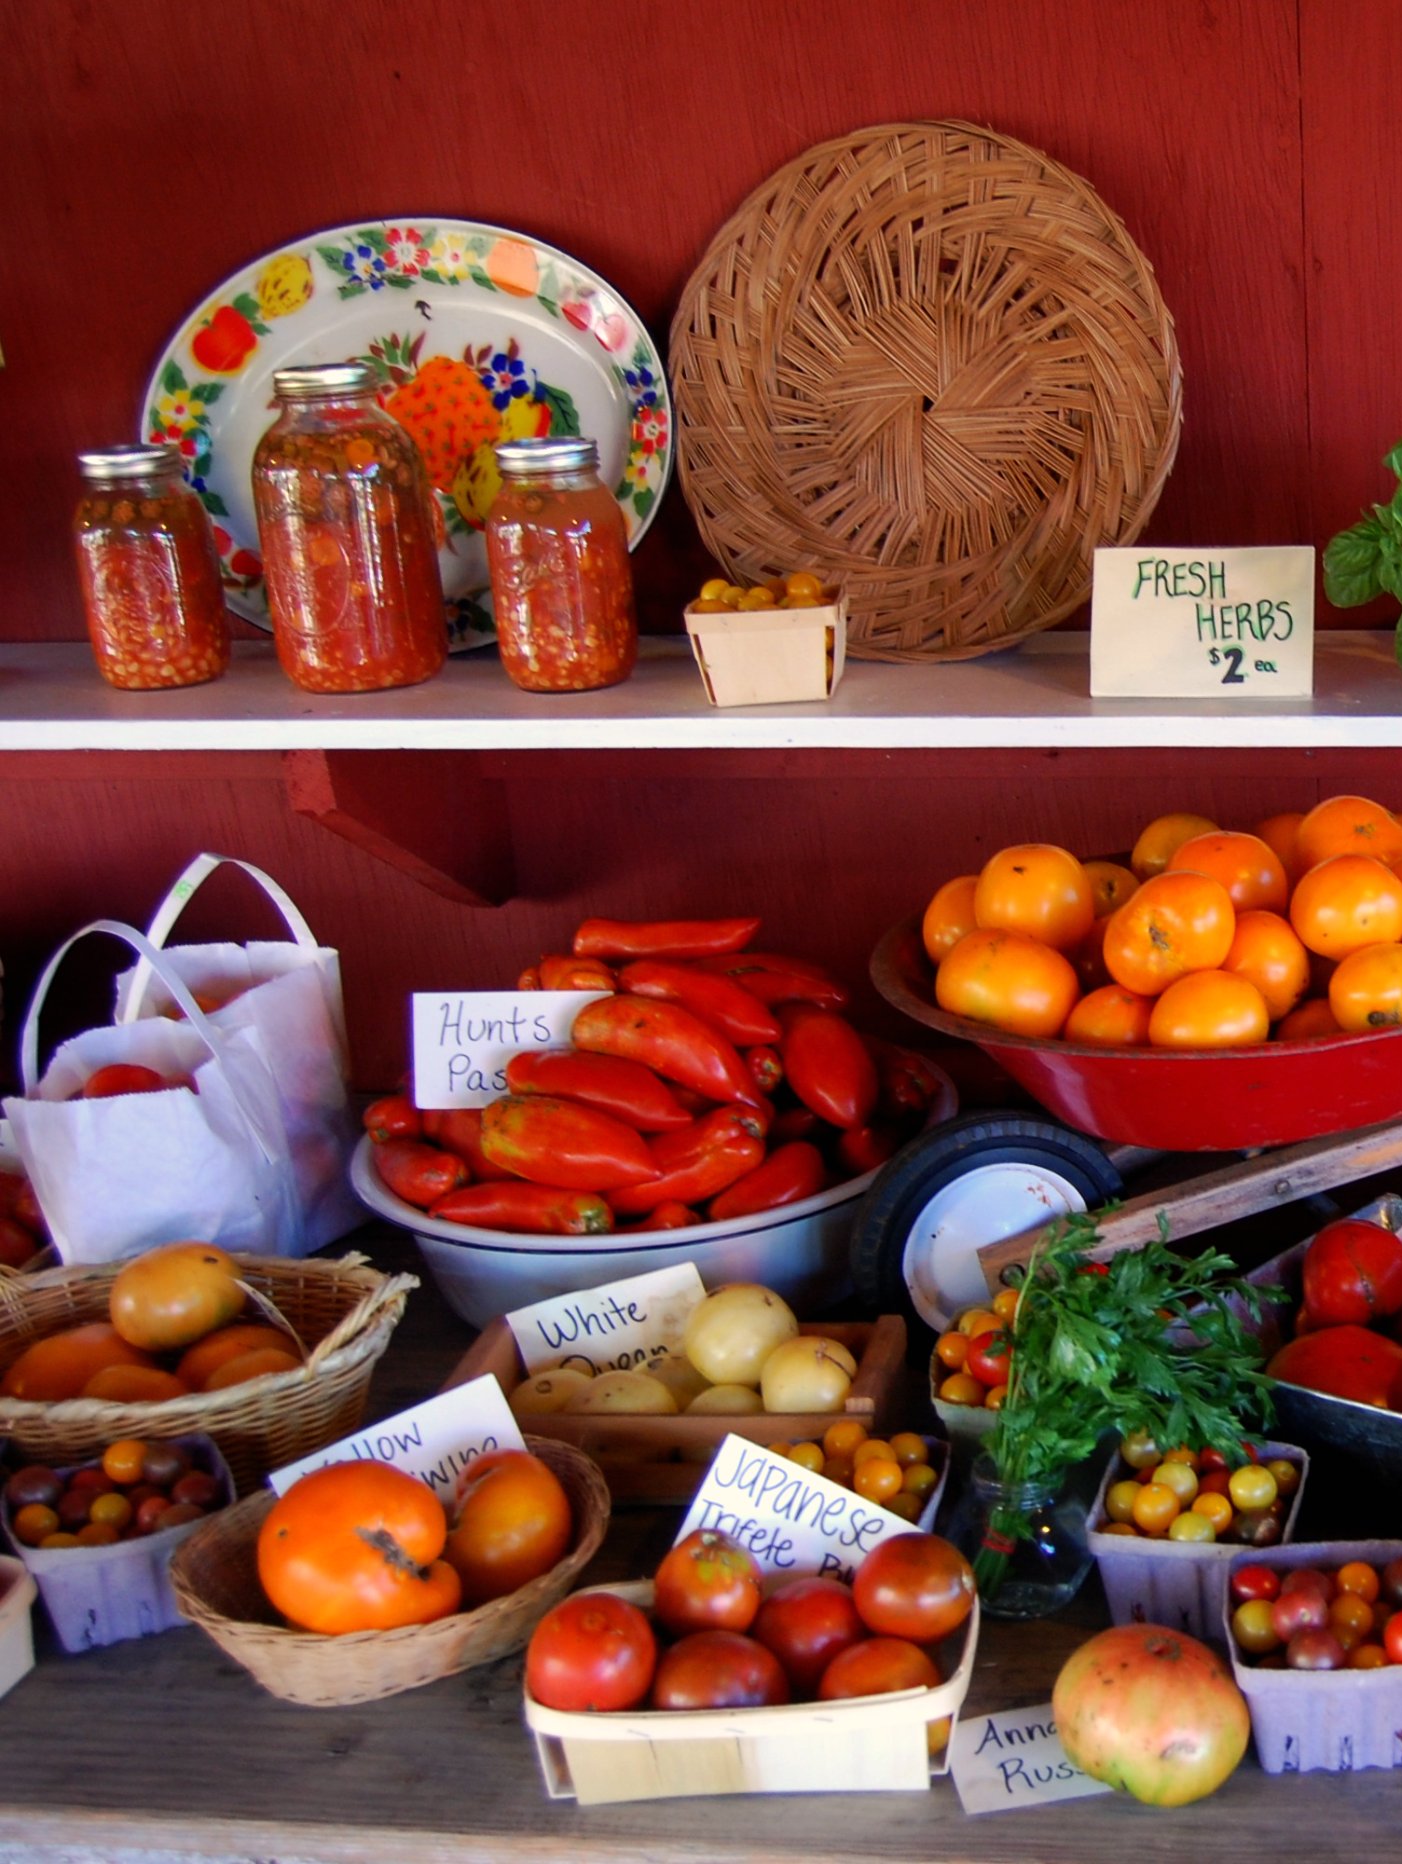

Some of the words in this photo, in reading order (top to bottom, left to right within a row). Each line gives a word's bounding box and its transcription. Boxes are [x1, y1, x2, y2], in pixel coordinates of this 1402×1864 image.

[1133, 559, 1226, 599] FRESH
[1195, 599, 1293, 641] HERBS
[1208, 646, 1245, 684] $2
[440, 1000, 551, 1046] Hunts
[448, 1053, 509, 1092] Pas
[536, 1297, 647, 1349] White
[715, 1449, 884, 1553] Japanese
